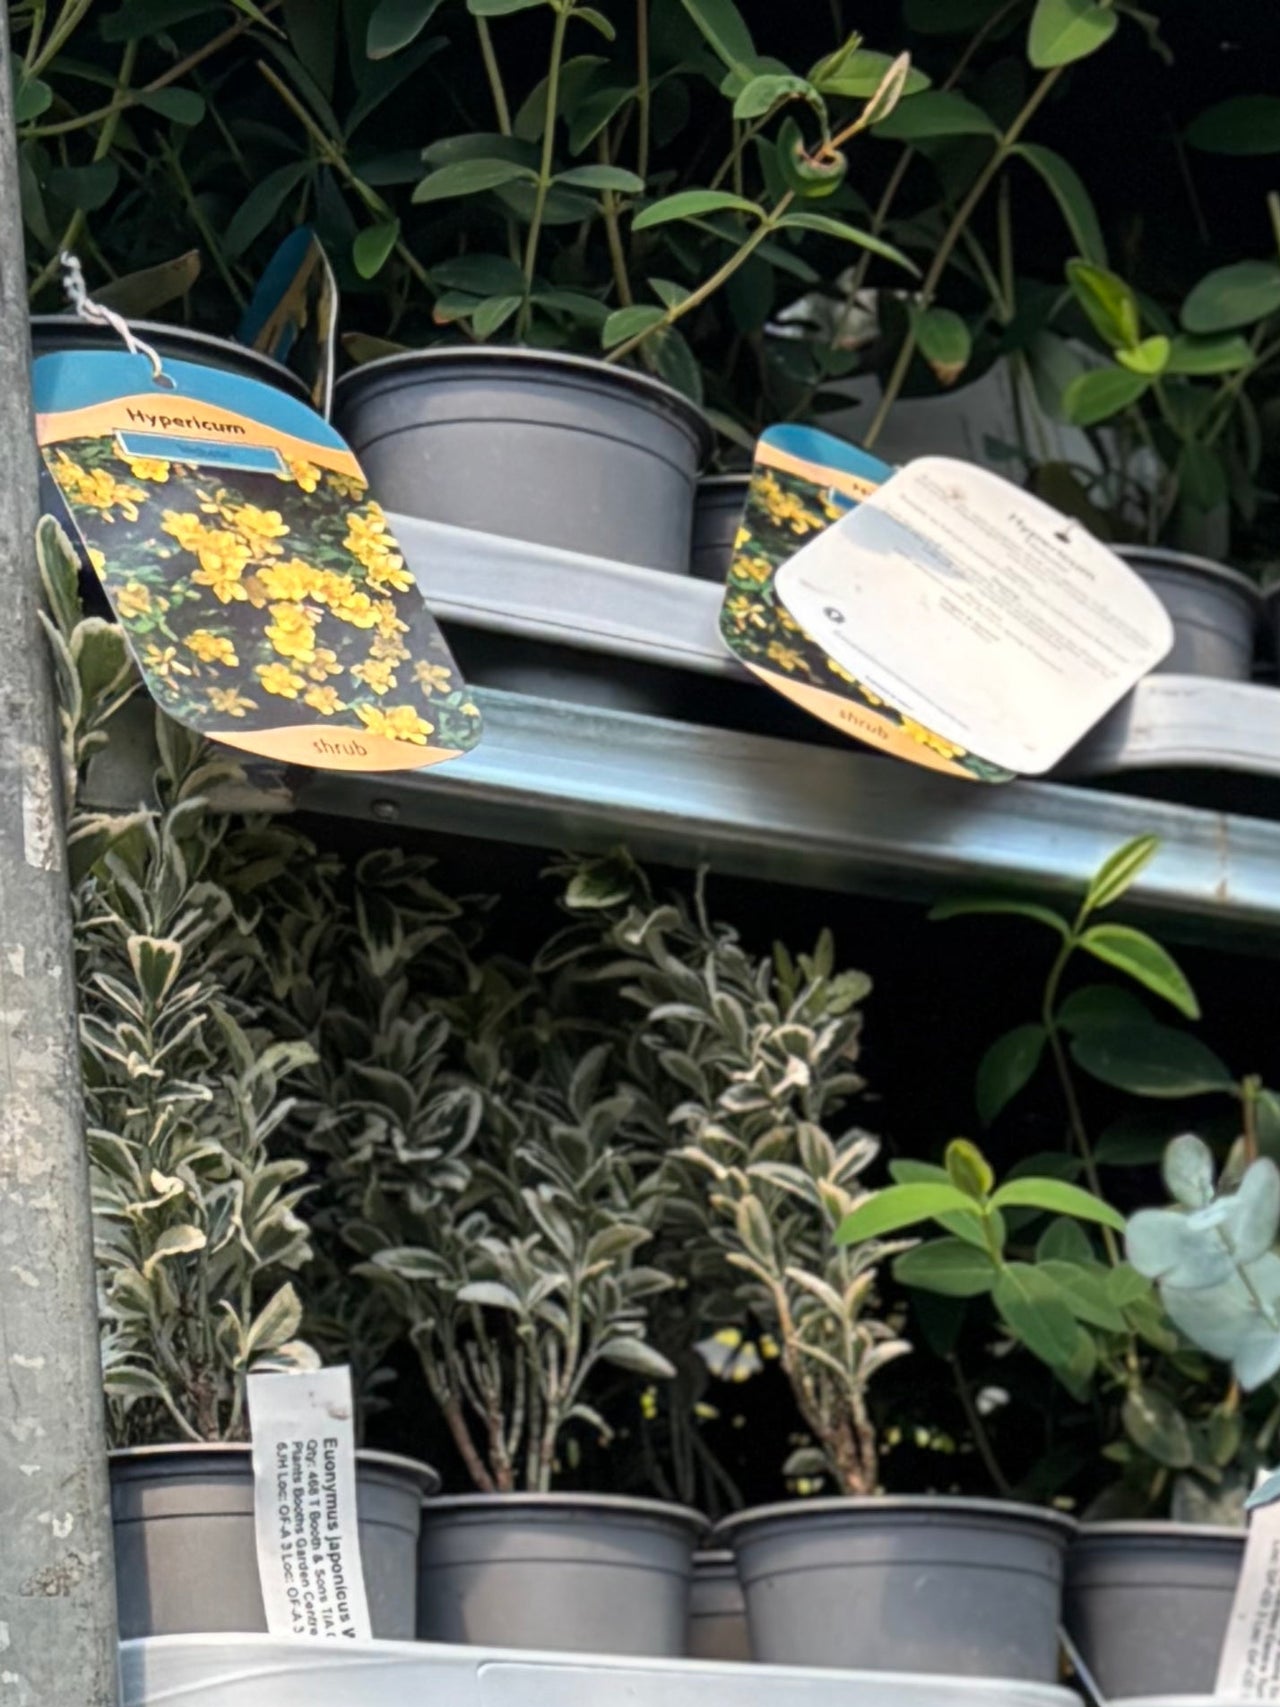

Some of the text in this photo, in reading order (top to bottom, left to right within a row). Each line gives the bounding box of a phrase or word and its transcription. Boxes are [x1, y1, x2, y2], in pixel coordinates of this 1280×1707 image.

[126, 407, 247, 435] Hypericum
[838, 707, 889, 740] shrub
[313, 738, 368, 756] shrub
[321, 1437, 339, 1531] Euonymus
[292, 1487, 305, 1535] Booths
[308, 1510, 322, 1551] Booth
[295, 1537, 310, 1588] Garden
[312, 1553, 324, 1564] &
[324, 1535, 351, 1623] japonicus
[314, 1568, 328, 1603] Sons
[303, 1591, 318, 1636] Centre
